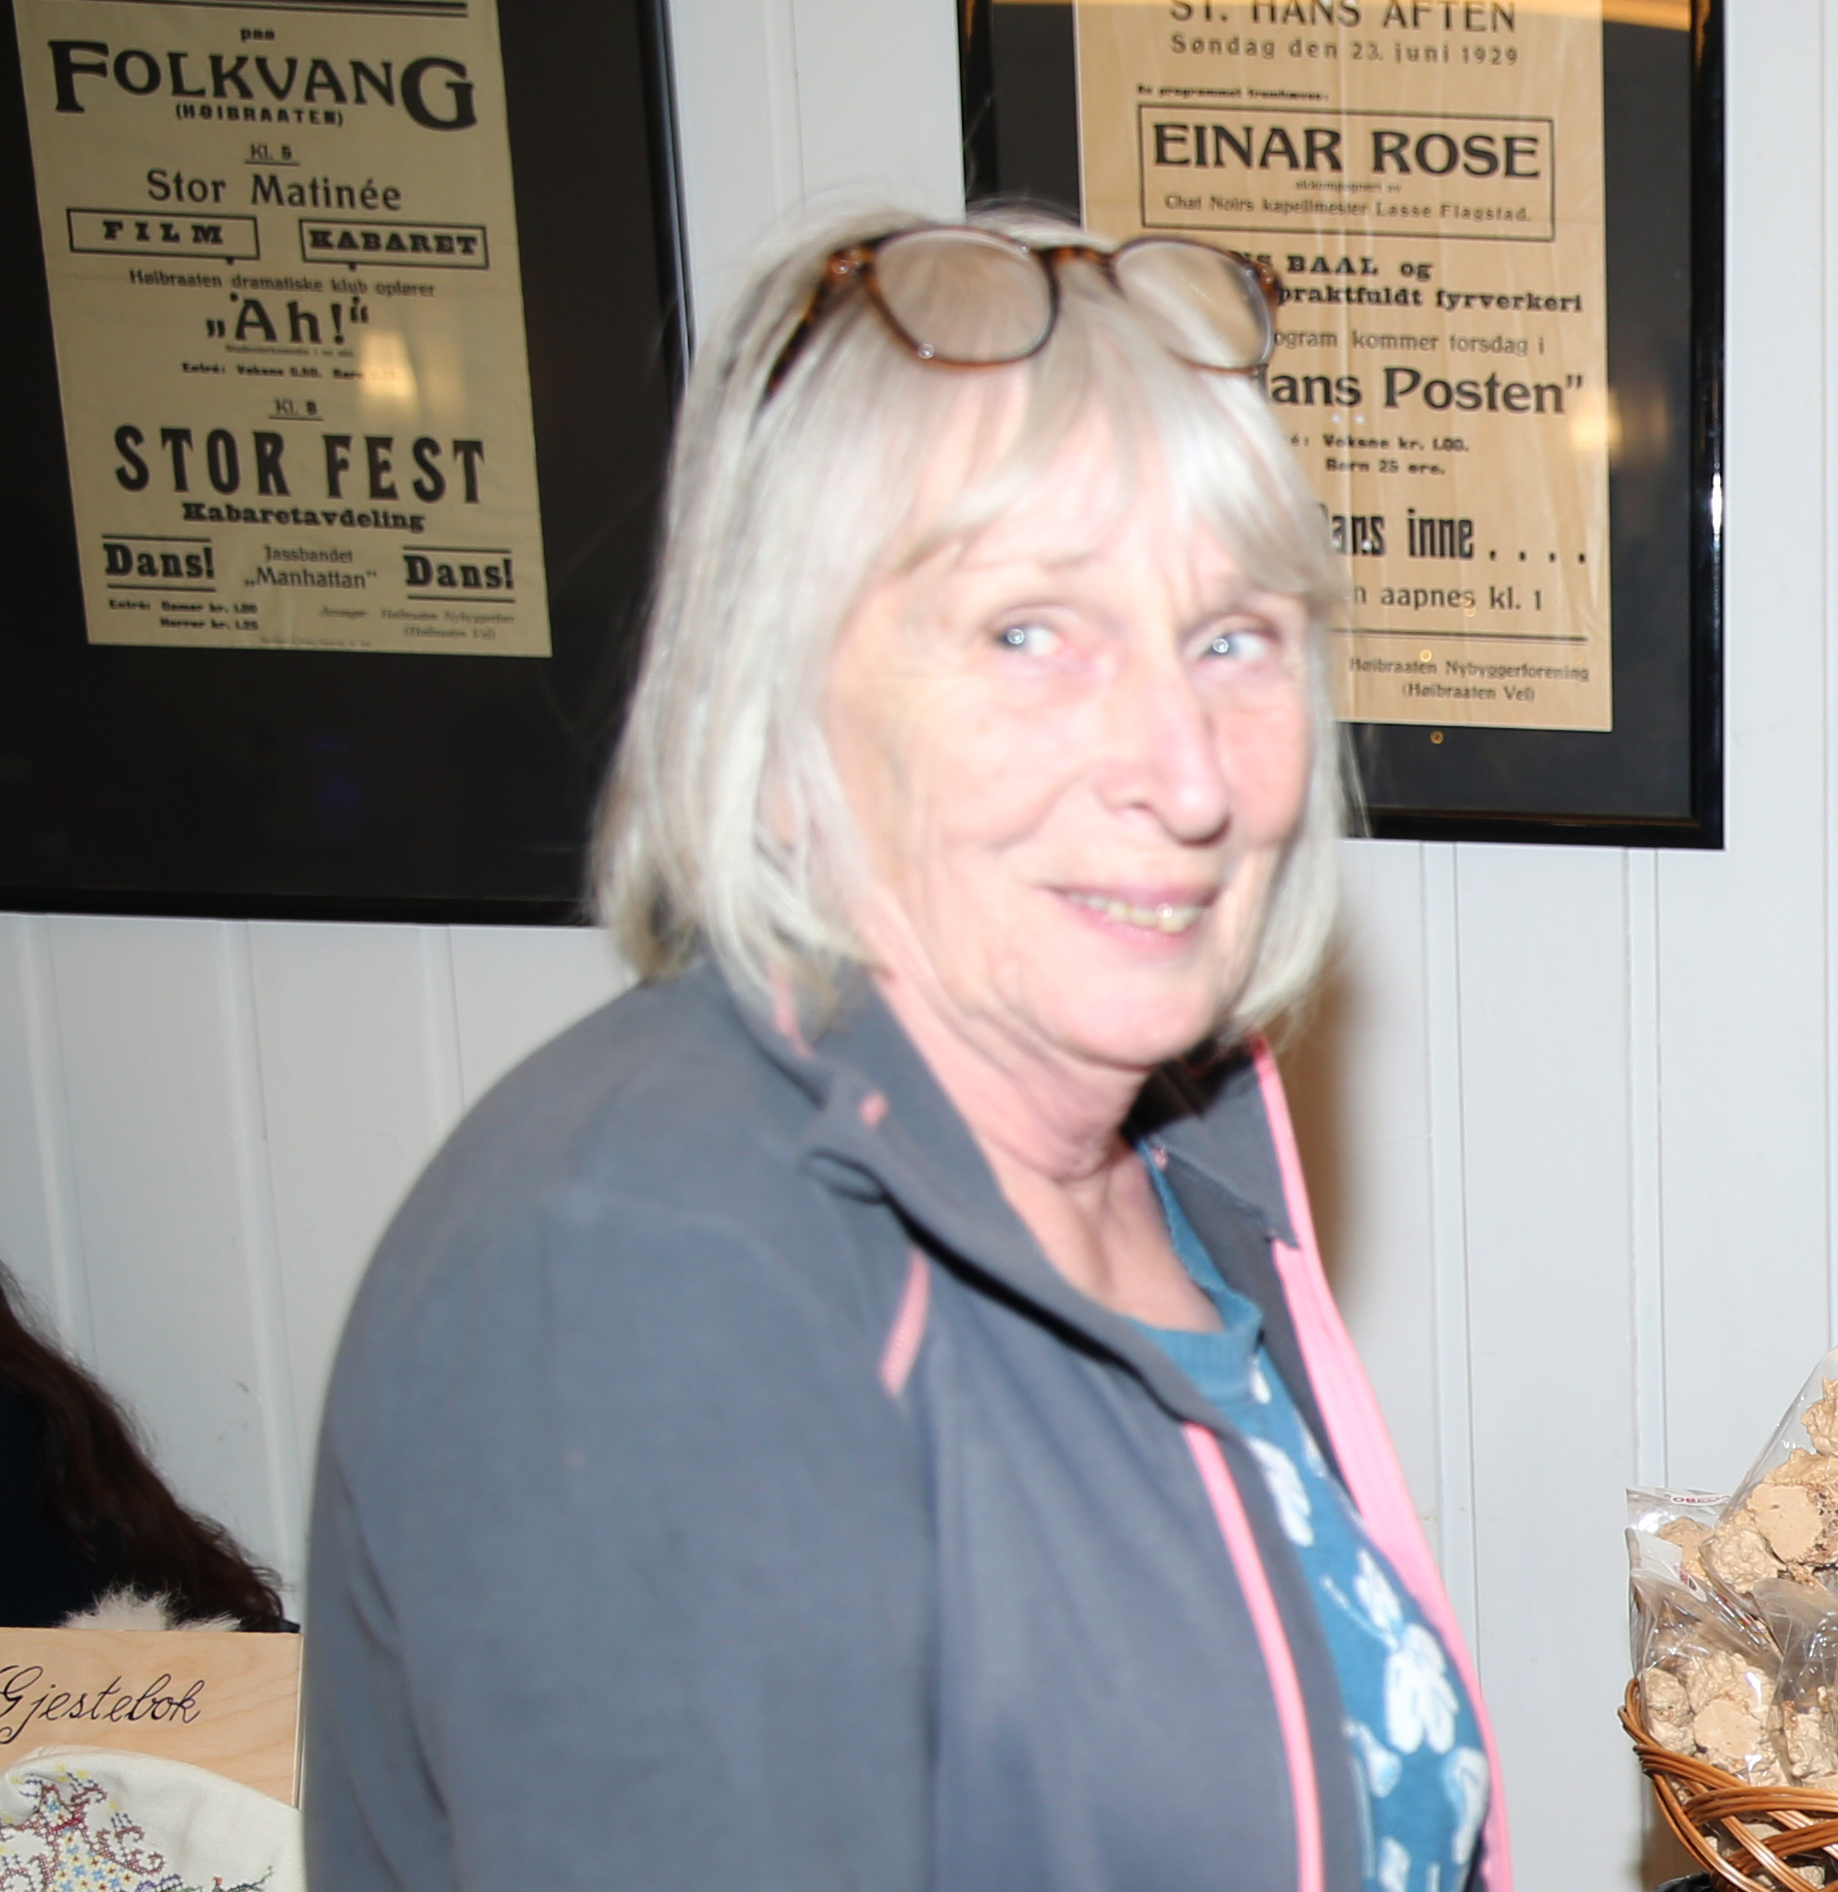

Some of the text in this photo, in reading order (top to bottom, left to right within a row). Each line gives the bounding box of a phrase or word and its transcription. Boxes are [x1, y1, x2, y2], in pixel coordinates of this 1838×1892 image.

[1382, 0, 1515, 33] AFTEN
[1171, 32, 1518, 67] Søndag den 23. juni 1929
[48, 39, 478, 131] FOLKVANG
[1154, 122, 1541, 179] EINAR ROSE
[147, 168, 402, 211] Stor Matinée
[1262, 196, 1367, 217] kapellmester
[1375, 201, 1432, 219] Lasse
[103, 220, 223, 244] FILM
[309, 229, 478, 256] KABARET
[1286, 254, 1379, 276] BAAL
[1401, 261, 1434, 281] og
[1276, 284, 1582, 313] praktfuldt fyrverkeri
[1274, 331, 1338, 349] ogram
[1352, 329, 1439, 351] kommer
[1449, 331, 1528, 356] torsdag
[1398, 437, 1425, 451] kr.
[115, 425, 485, 505] STOR FEST
[1378, 459, 1399, 474] 25
[183, 501, 427, 534] Kabaretavdeling
[1324, 507, 1475, 560] ans inne
[103, 542, 215, 580] Dans!
[403, 554, 514, 591] Dans!
[1380, 586, 1477, 611] aapnes
[1489, 586, 1522, 611] kl.
[0, 1664, 206, 1745] Gjestebok
